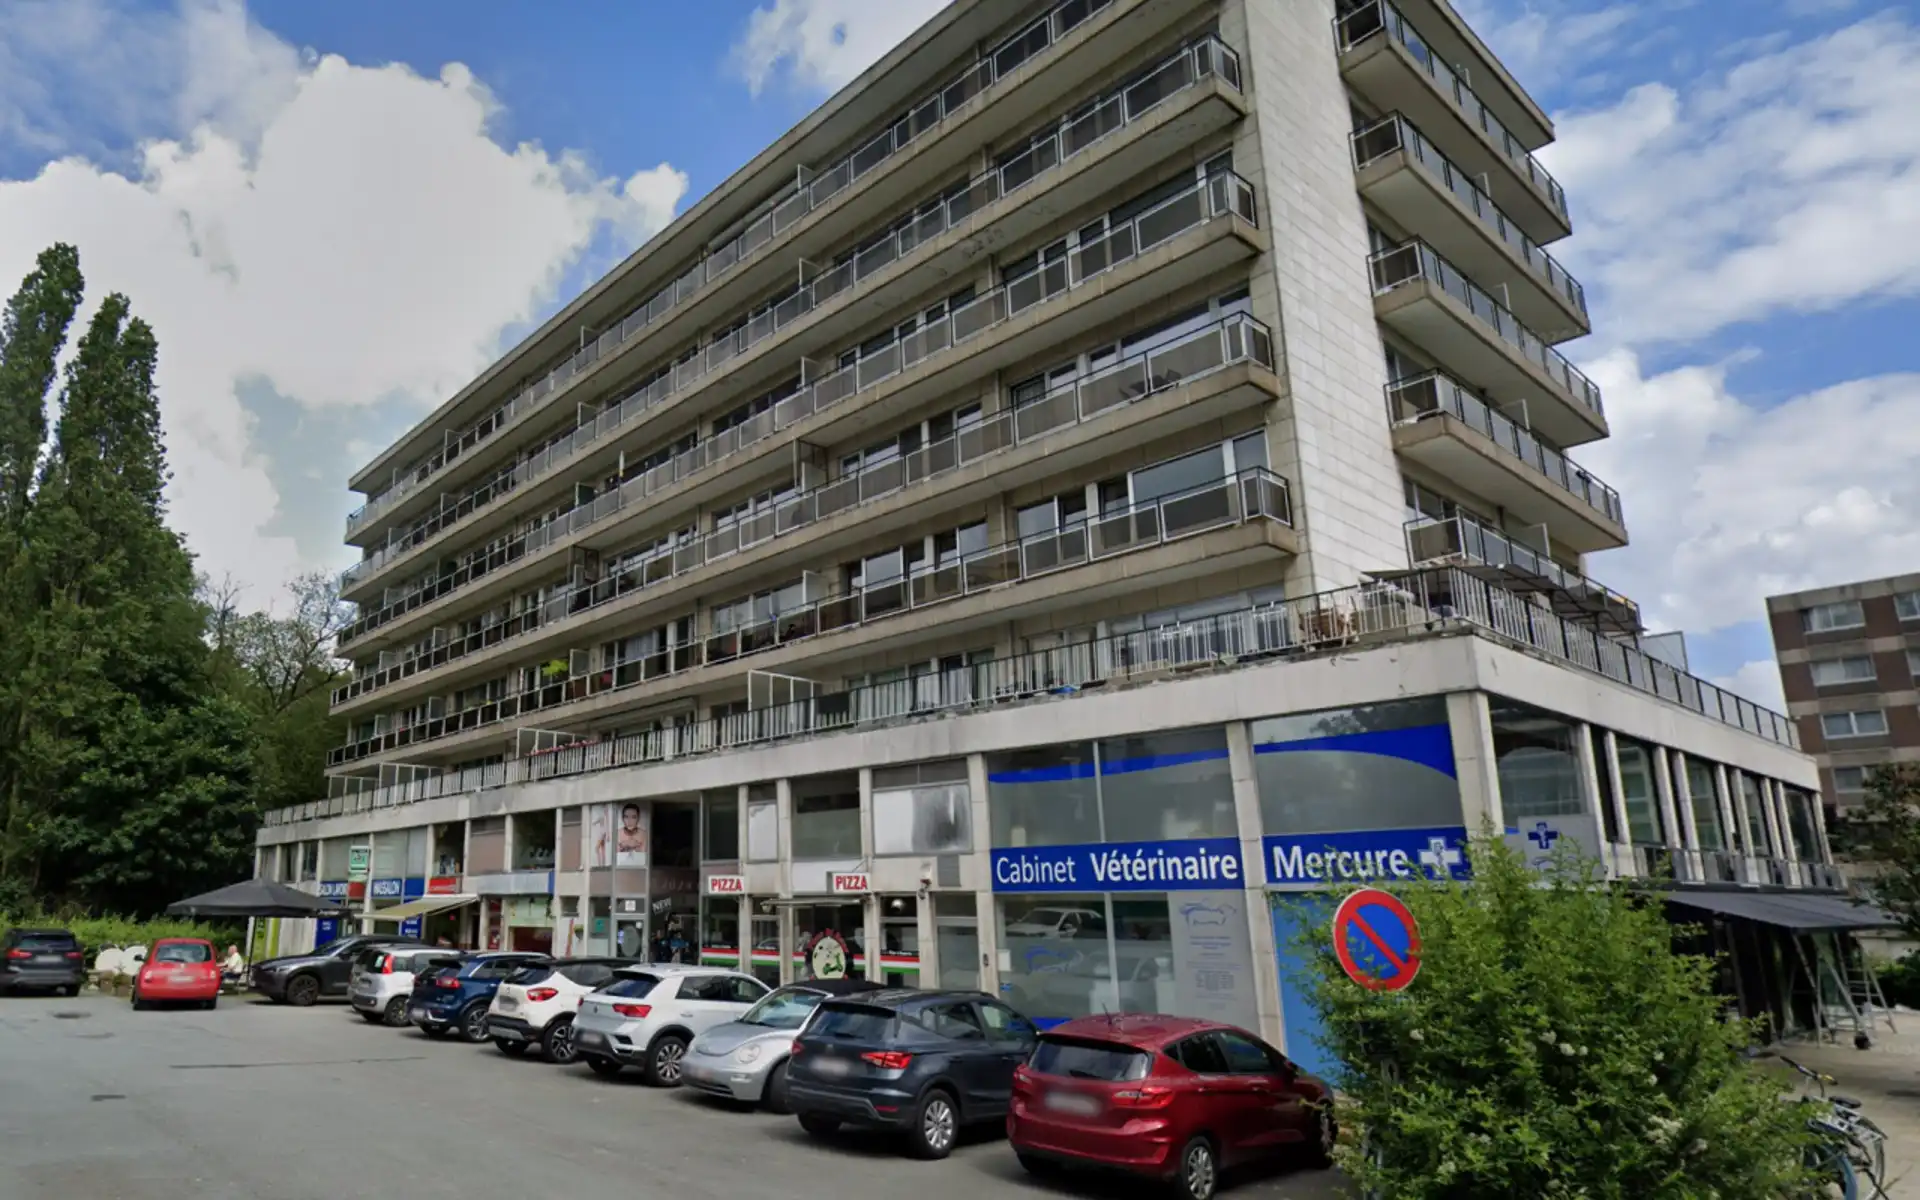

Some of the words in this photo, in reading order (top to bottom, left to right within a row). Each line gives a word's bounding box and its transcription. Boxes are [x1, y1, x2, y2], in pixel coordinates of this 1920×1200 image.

[996, 855, 1076, 883] Cabinet
[1089, 847, 1238, 882] Vétérinaire
[1273, 845, 1409, 879] Mercure
[711, 878, 742, 892] PIZZA
[835, 875, 868, 891] PIZZA
